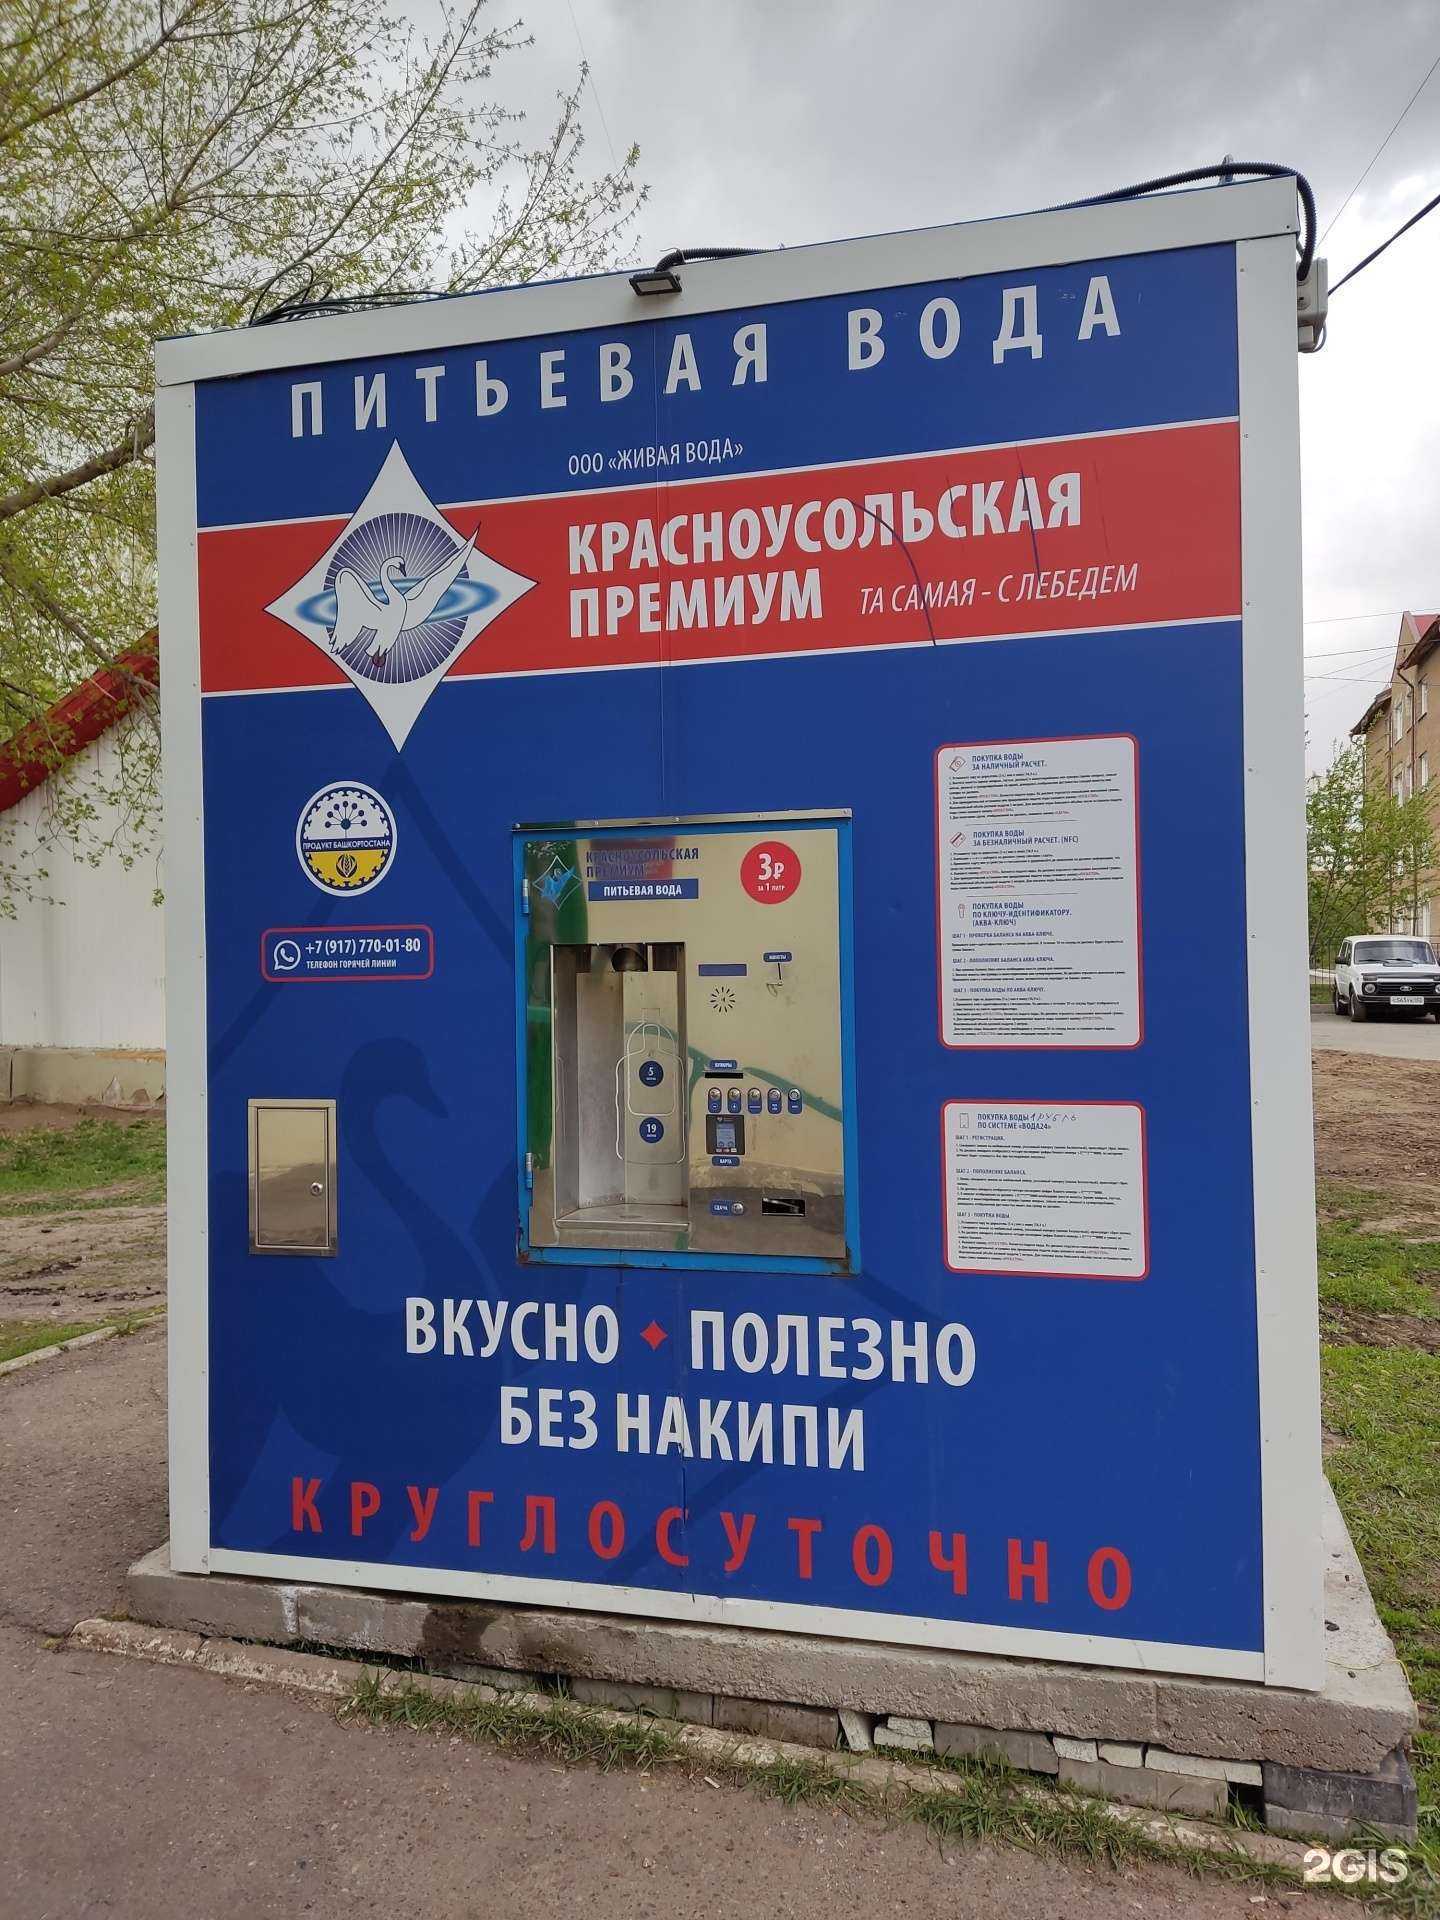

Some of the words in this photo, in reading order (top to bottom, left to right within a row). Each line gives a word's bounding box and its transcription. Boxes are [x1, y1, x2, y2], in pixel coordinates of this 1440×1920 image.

[291, 323, 768, 438] ПИТЬЕВАЯ
[848, 275, 1122, 371] ВОДА
[568, 451, 604, 476] ООО
[608, 442, 681, 472] «ЖИВАЯ
[685, 438, 745, 466] ВОДА»
[568, 471, 1082, 576] КРАСНОУСОЛЬСКАЯ
[860, 587, 888, 615] ТА
[891, 577, 977, 613] САМАЯ
[998, 574, 1011, 604] С
[1015, 562, 1140, 603] ЛЕБЕДЕМ
[569, 567, 824, 639] ПРЕМИУМ
[972, 754, 1002, 763] ПОКУПКА
[1003, 752, 1024, 762] ВОДЫ
[972, 763, 981, 771] ЗА
[981, 761, 1020, 770] НАЛИЧНЫЙ
[973, 830, 1004, 839] ПОКУПКА
[1005, 829, 1025, 838] ВОДЫ
[982, 837, 1033, 846] БЕЗНАЛИЧНЫЙ
[1061, 835, 1079, 844] (NFC)
[302, 841, 333, 851] ПРОДУКТ
[333, 839, 391, 849] БАШКОРТОСТАНА
[603, 885, 654, 897] ПИТЬЕВАЯ
[655, 884, 682, 896] ВОДА
[305, 940, 323, 955] +7
[325, 938, 357, 956] (917)
[358, 937, 421, 954] 770-01-80
[306, 959, 338, 969] ТЕЛЕФОН
[339, 958, 370, 968] ГОРЯЧЕЙ
[371, 959, 397, 968] ЛИНИИ
[648, 1066, 654, 1077] 5
[977, 1113, 1008, 1121] ПОКУПКА
[1009, 1114, 1029, 1122] ВОДЫ
[646, 1123, 657, 1134] 19
[404, 1296, 621, 1365] ВКУСНО
[690, 1310, 977, 1387] ПОЛЕЗНО
[500, 1386, 599, 1450] БЕЗ
[616, 1392, 866, 1472] НАКИПИ
[291, 1476, 1133, 1611] КРУГЛОСУТОЧНО
